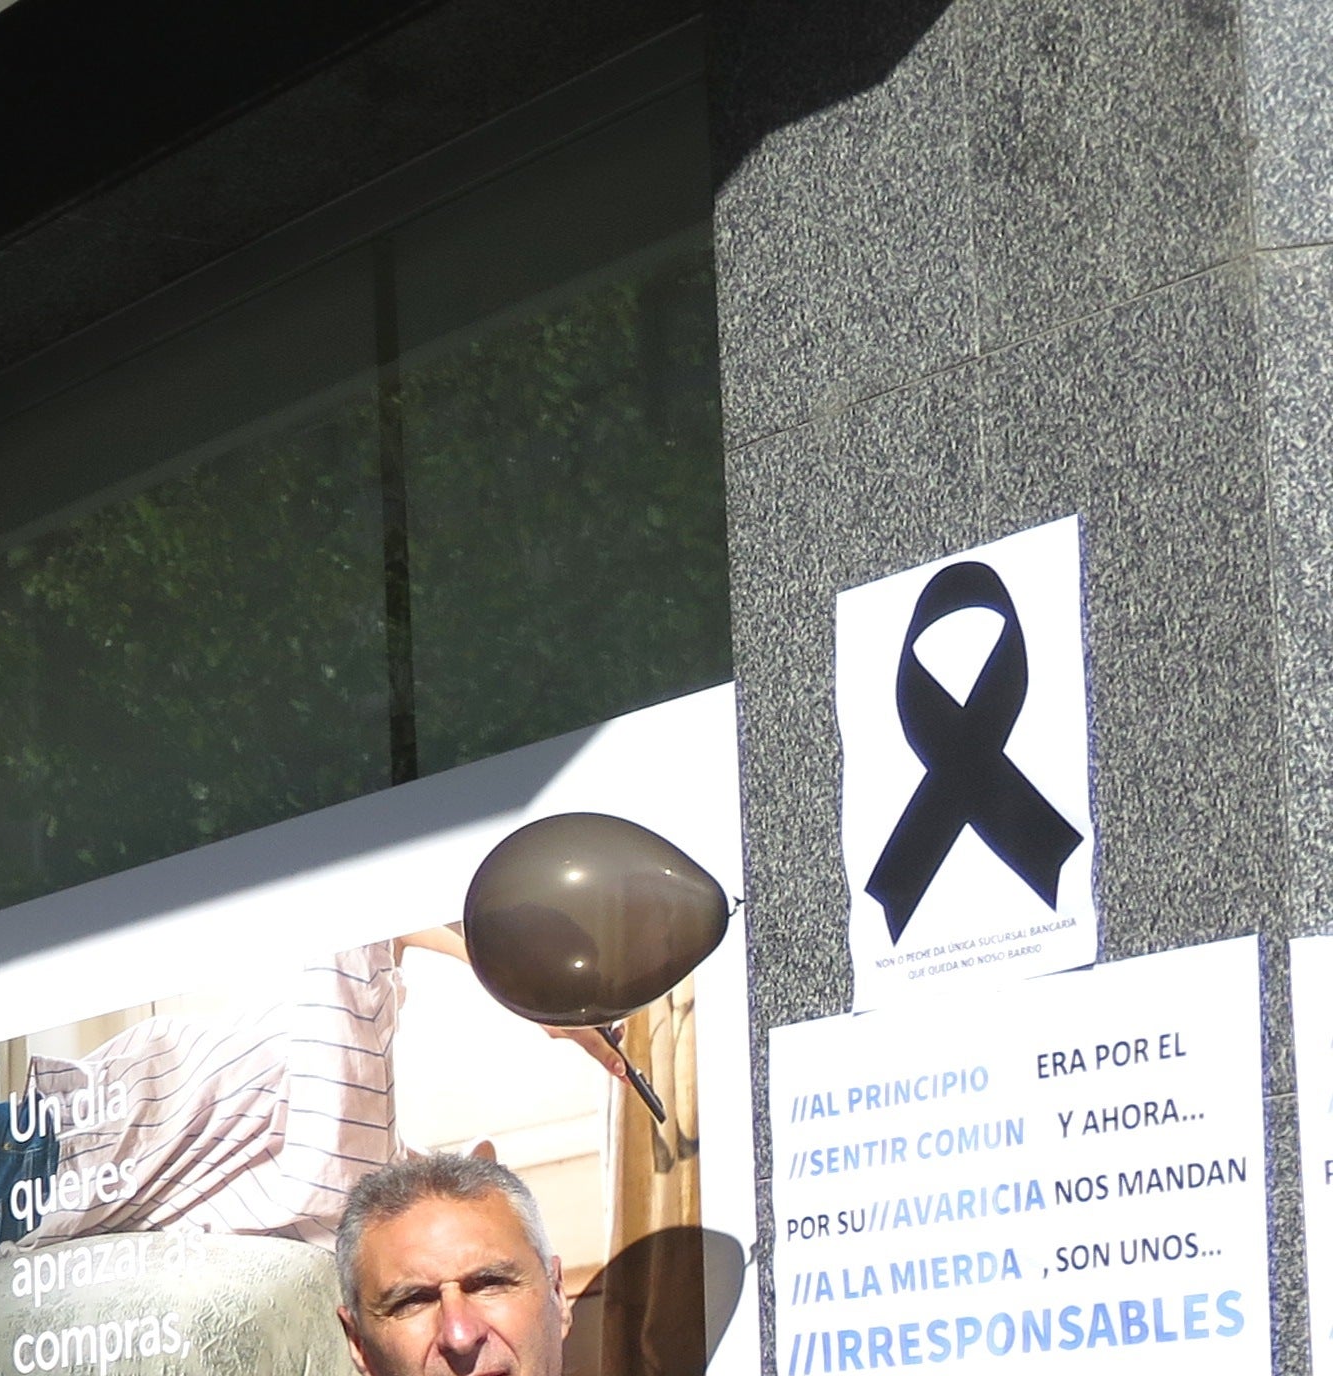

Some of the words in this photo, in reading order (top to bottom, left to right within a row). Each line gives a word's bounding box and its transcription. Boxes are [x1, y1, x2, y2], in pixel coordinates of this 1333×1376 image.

[874, 957, 896, 969] NON
[933, 946, 946, 957] DA
[978, 929, 1027, 947] SUCURSAL
[1030, 917, 1077, 937] BANCARIA
[907, 967, 926, 980] QUE
[927, 960, 959, 976] QUEDA
[961, 957, 975, 968] NO
[977, 951, 1006, 965] NOSO
[1008, 943, 1042, 960] BARRIO
[9, 1087, 61, 1143] Un
[71, 1069, 129, 1129] día
[791, 1091, 841, 1124] //AL
[847, 1065, 989, 1114] PRINCIPIO
[1036, 1048, 1087, 1079] ERA
[1095, 1037, 1149, 1070] POR
[1158, 1032, 1187, 1060] EL
[788, 1136, 908, 1181] //SENTIR
[916, 1117, 1025, 1160] COMUN
[1057, 1110, 1074, 1139] Y
[1081, 1097, 1205, 1136] AHORA...
[9, 1157, 139, 1231] queres
[786, 1213, 831, 1242] POR
[1054, 1174, 1109, 1205] NOS
[1118, 1156, 1247, 1198] MANDAN
[11, 1235, 154, 1308] aprazar
[164, 1224, 209, 1271] as
[791, 1270, 835, 1306] //A
[842, 1265, 883, 1300] LA
[889, 1247, 1023, 1295] MIERDA
[1120, 1232, 1222, 1265] UNOS...
[12, 1311, 191, 1376] compras,
